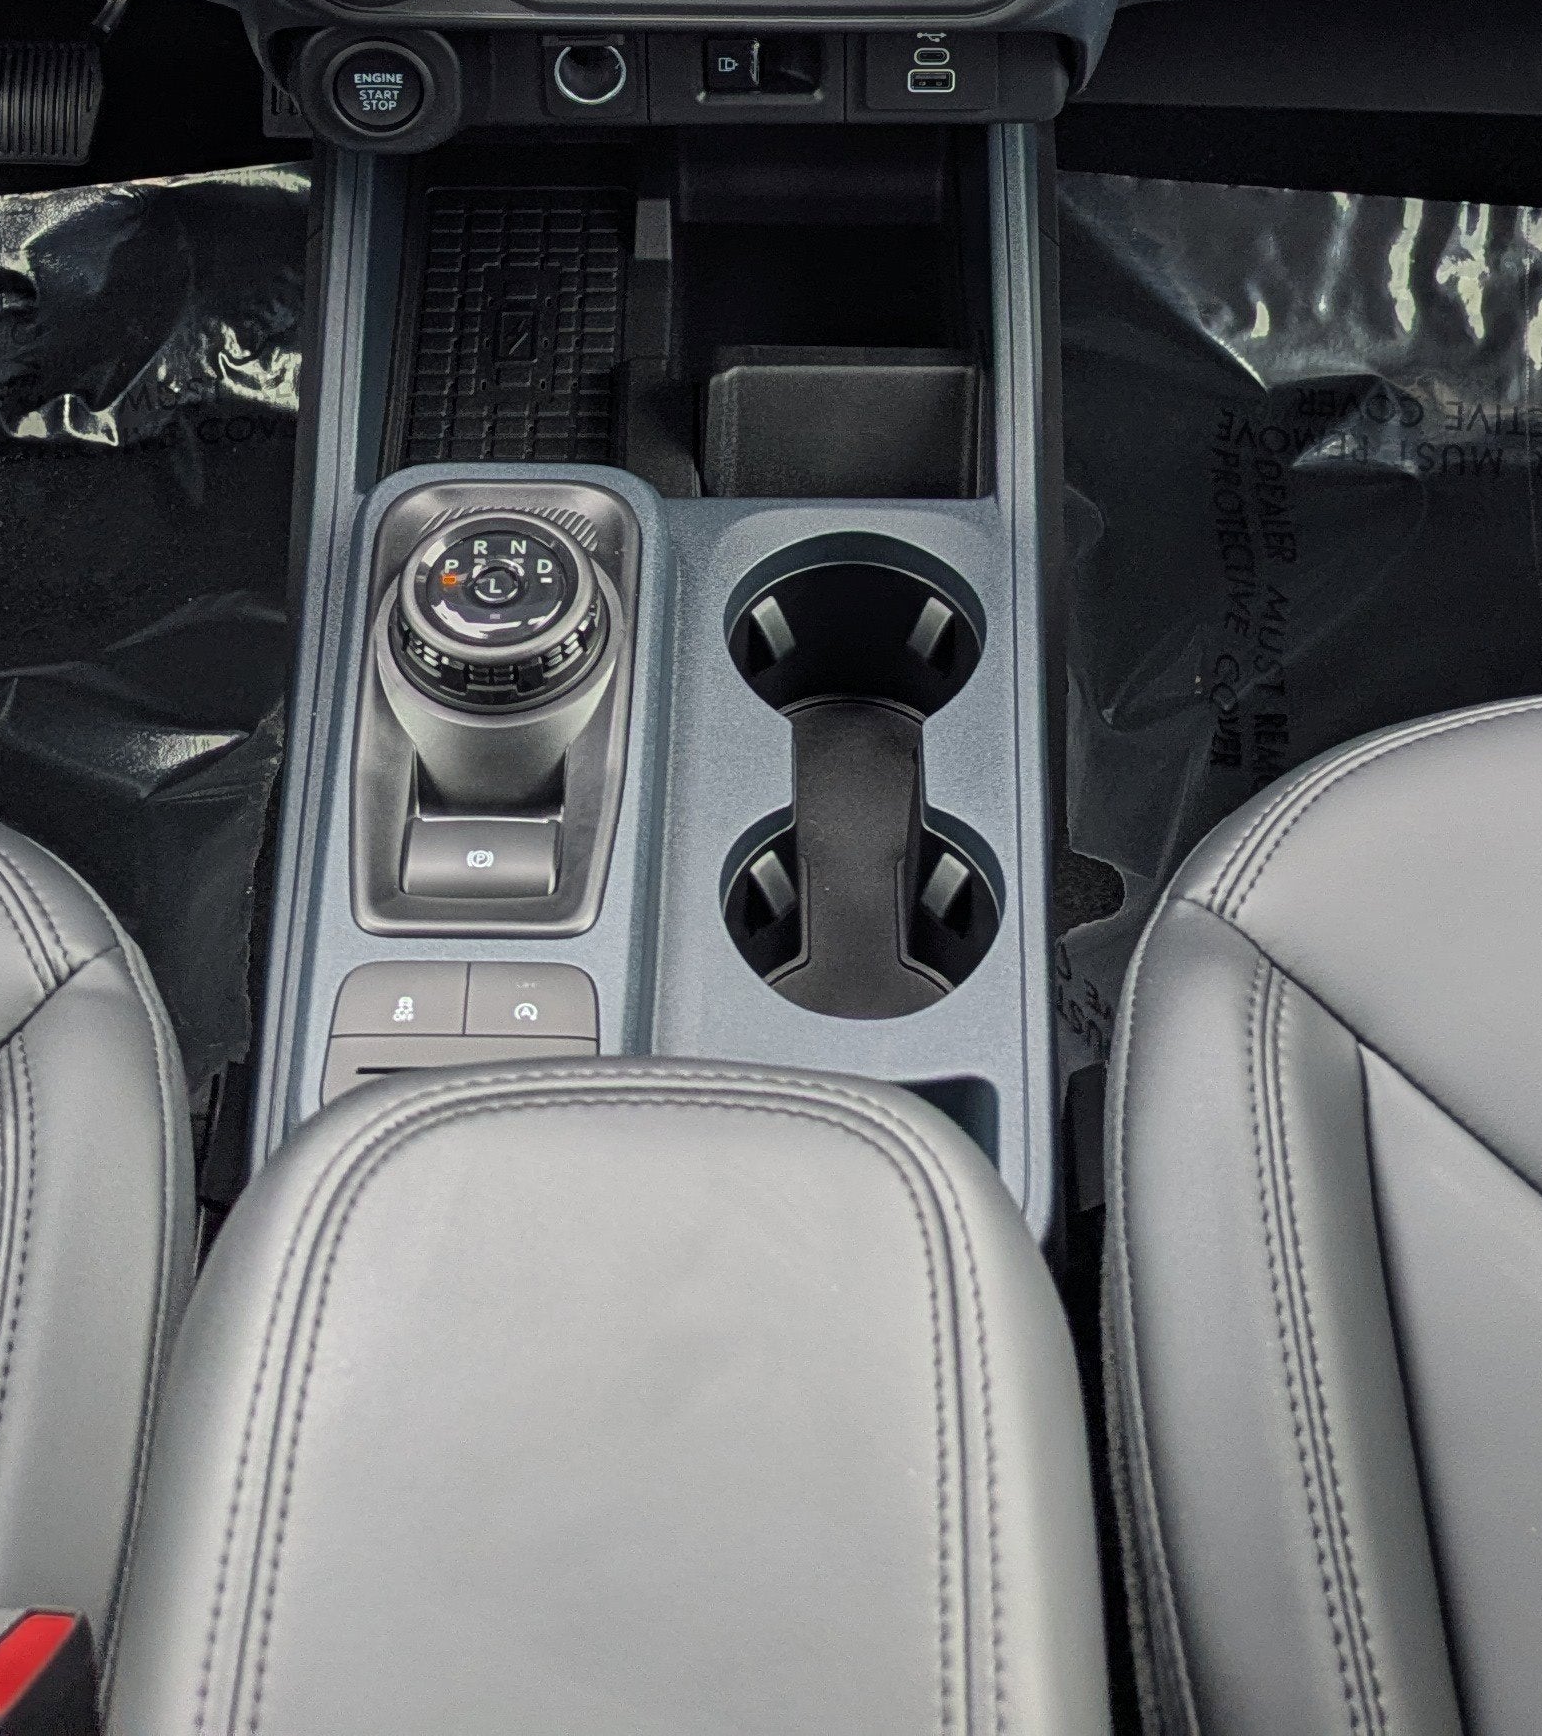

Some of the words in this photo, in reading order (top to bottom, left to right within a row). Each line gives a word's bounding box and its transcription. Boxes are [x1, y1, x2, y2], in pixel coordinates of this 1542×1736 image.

[354, 73, 403, 84] ENGINE
[359, 90, 399, 101] START
[362, 100, 397, 111] STOP
[474, 539, 488, 555] R
[511, 539, 527, 555] N
[445, 558, 459, 575] P
[537, 558, 553, 574] D
[490, 578, 502, 595] L
